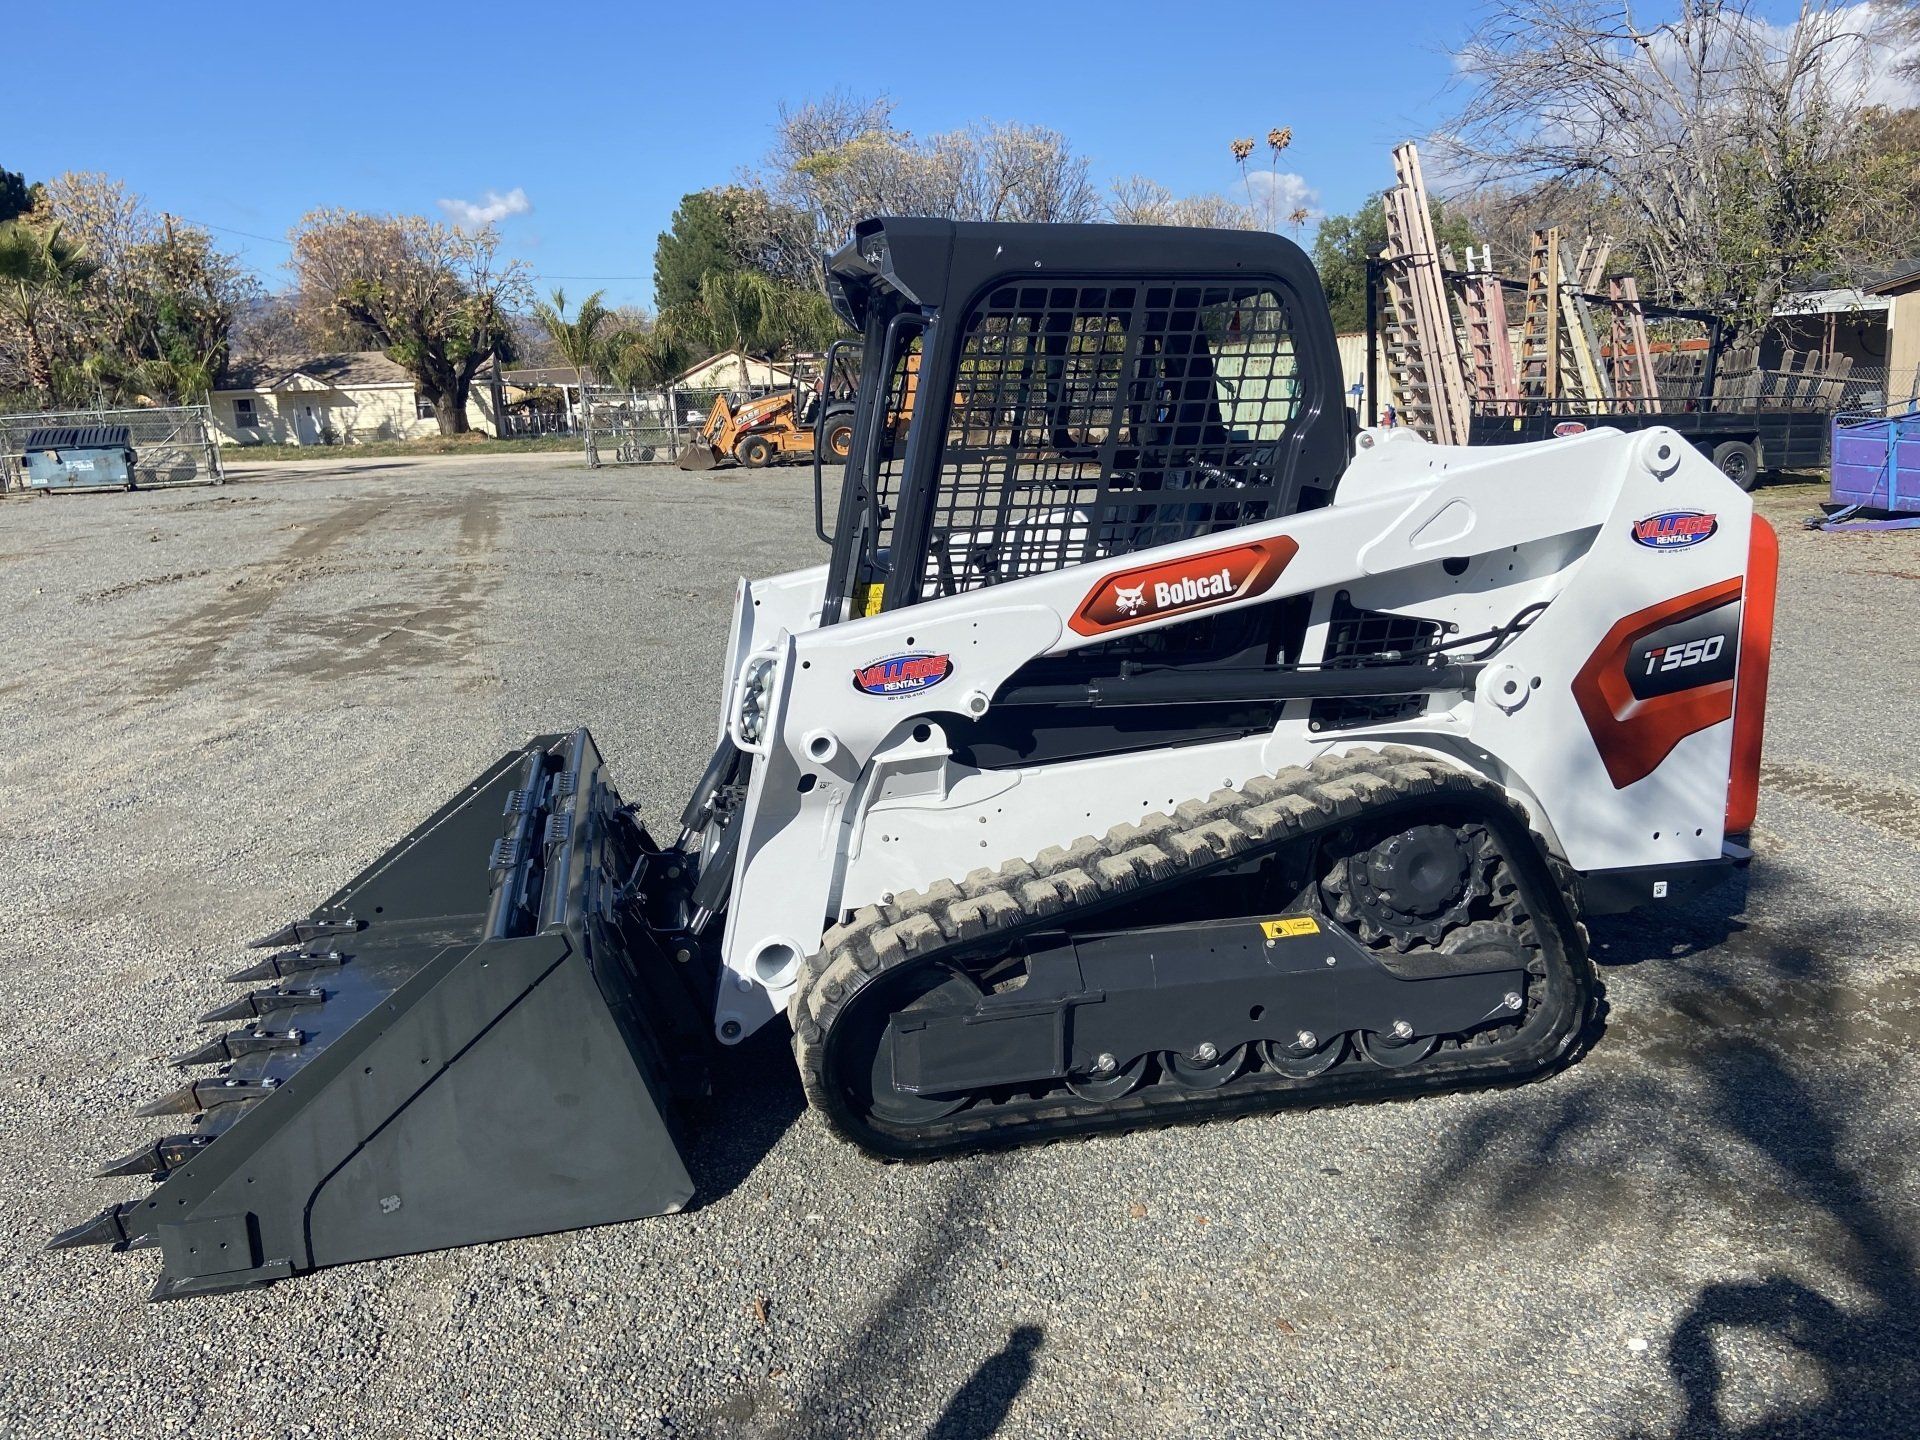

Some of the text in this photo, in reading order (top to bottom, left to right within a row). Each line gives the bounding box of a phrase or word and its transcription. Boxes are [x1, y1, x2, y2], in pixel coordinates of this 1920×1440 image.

[736, 409, 760, 424] CASE
[1633, 513, 1717, 539] VILLAGE
[1656, 534, 1693, 545] RENTALS
[1154, 568, 1233, 608] Bobcat
[1644, 634, 1724, 675] T550
[853, 654, 949, 688] VILLAGE
[884, 678, 925, 692] RENTALS
